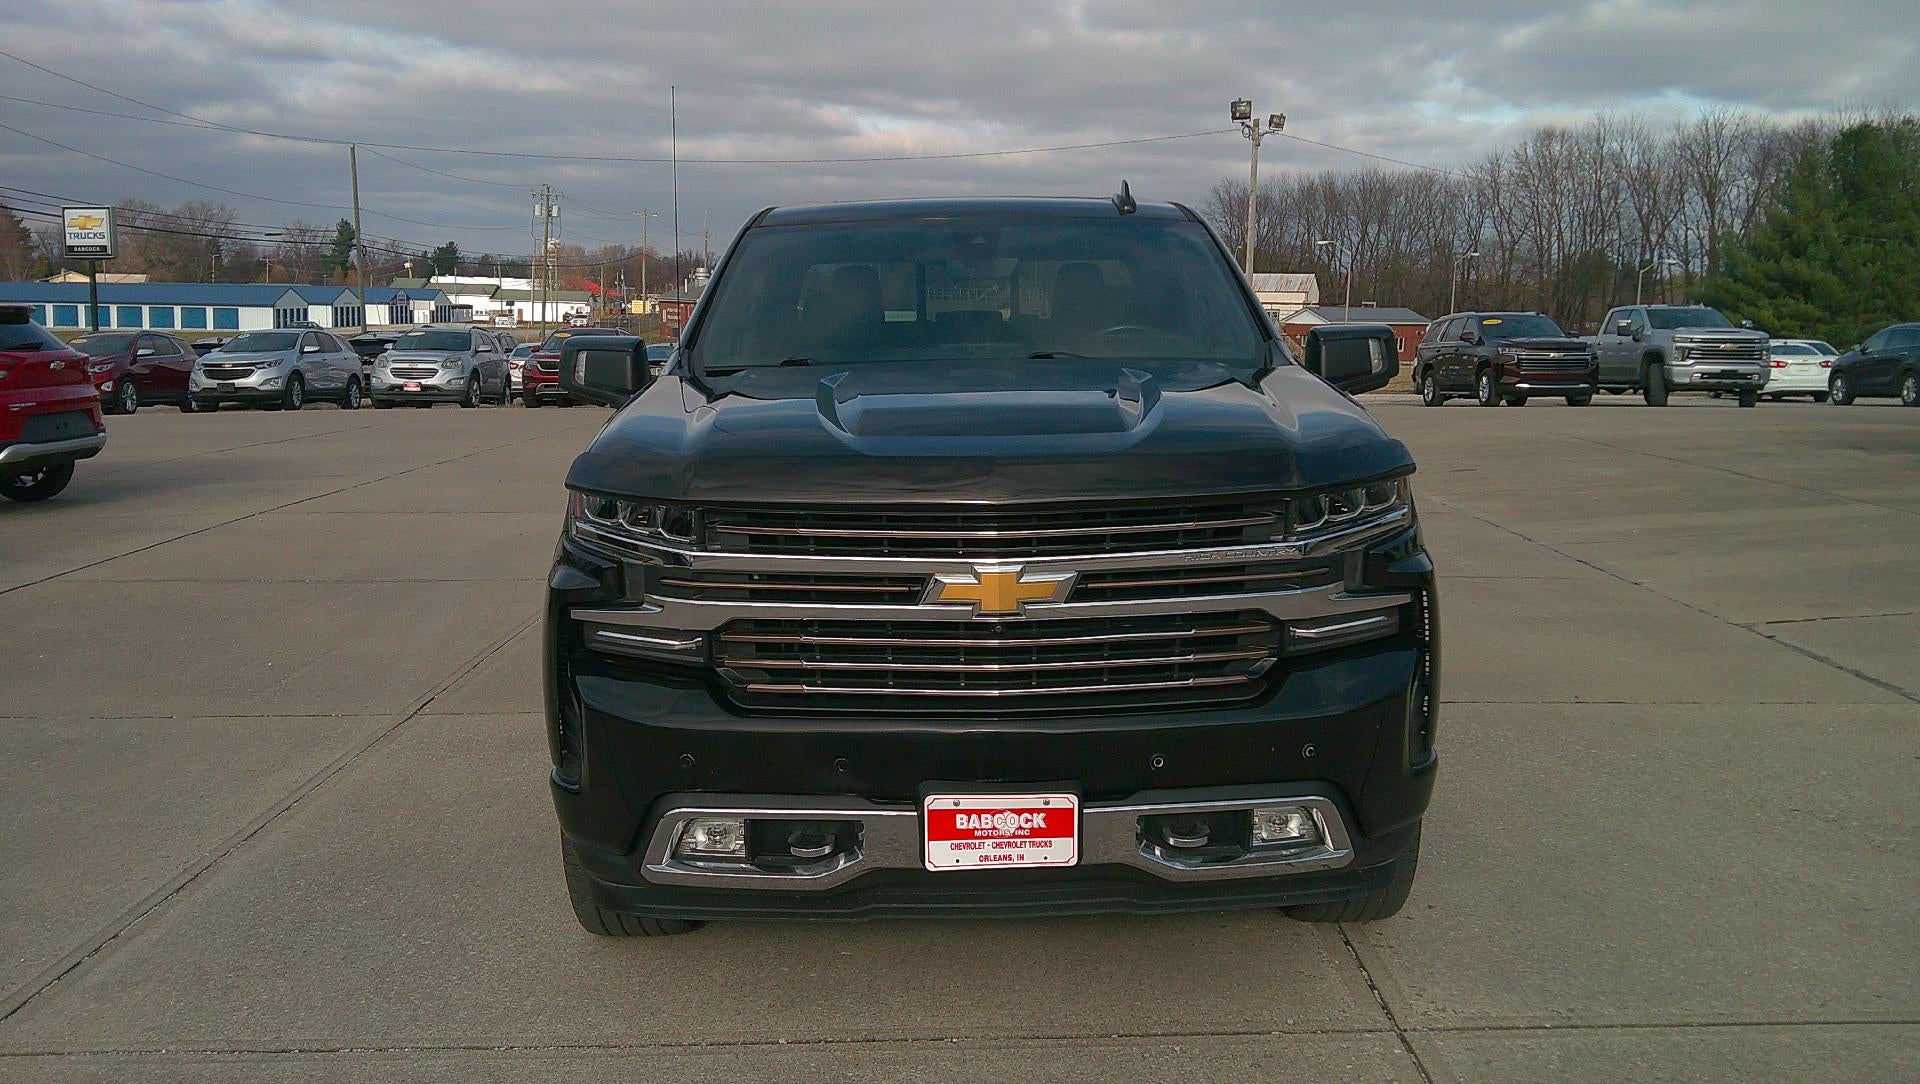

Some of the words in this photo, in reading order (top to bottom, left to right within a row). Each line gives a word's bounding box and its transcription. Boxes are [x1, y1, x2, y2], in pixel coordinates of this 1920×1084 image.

[68, 231, 105, 240] TRUCKS
[1225, 547, 1297, 559] COUNTRY
[955, 812, 1047, 830] BABCOCK
[950, 841, 986, 851] CHEVROLET
[991, 840, 1027, 849] CHEVROLET
[1028, 840, 1053, 849] TRUCKS
[978, 854, 1014, 863] ORLEANS,
[1016, 853, 1025, 861] IN
